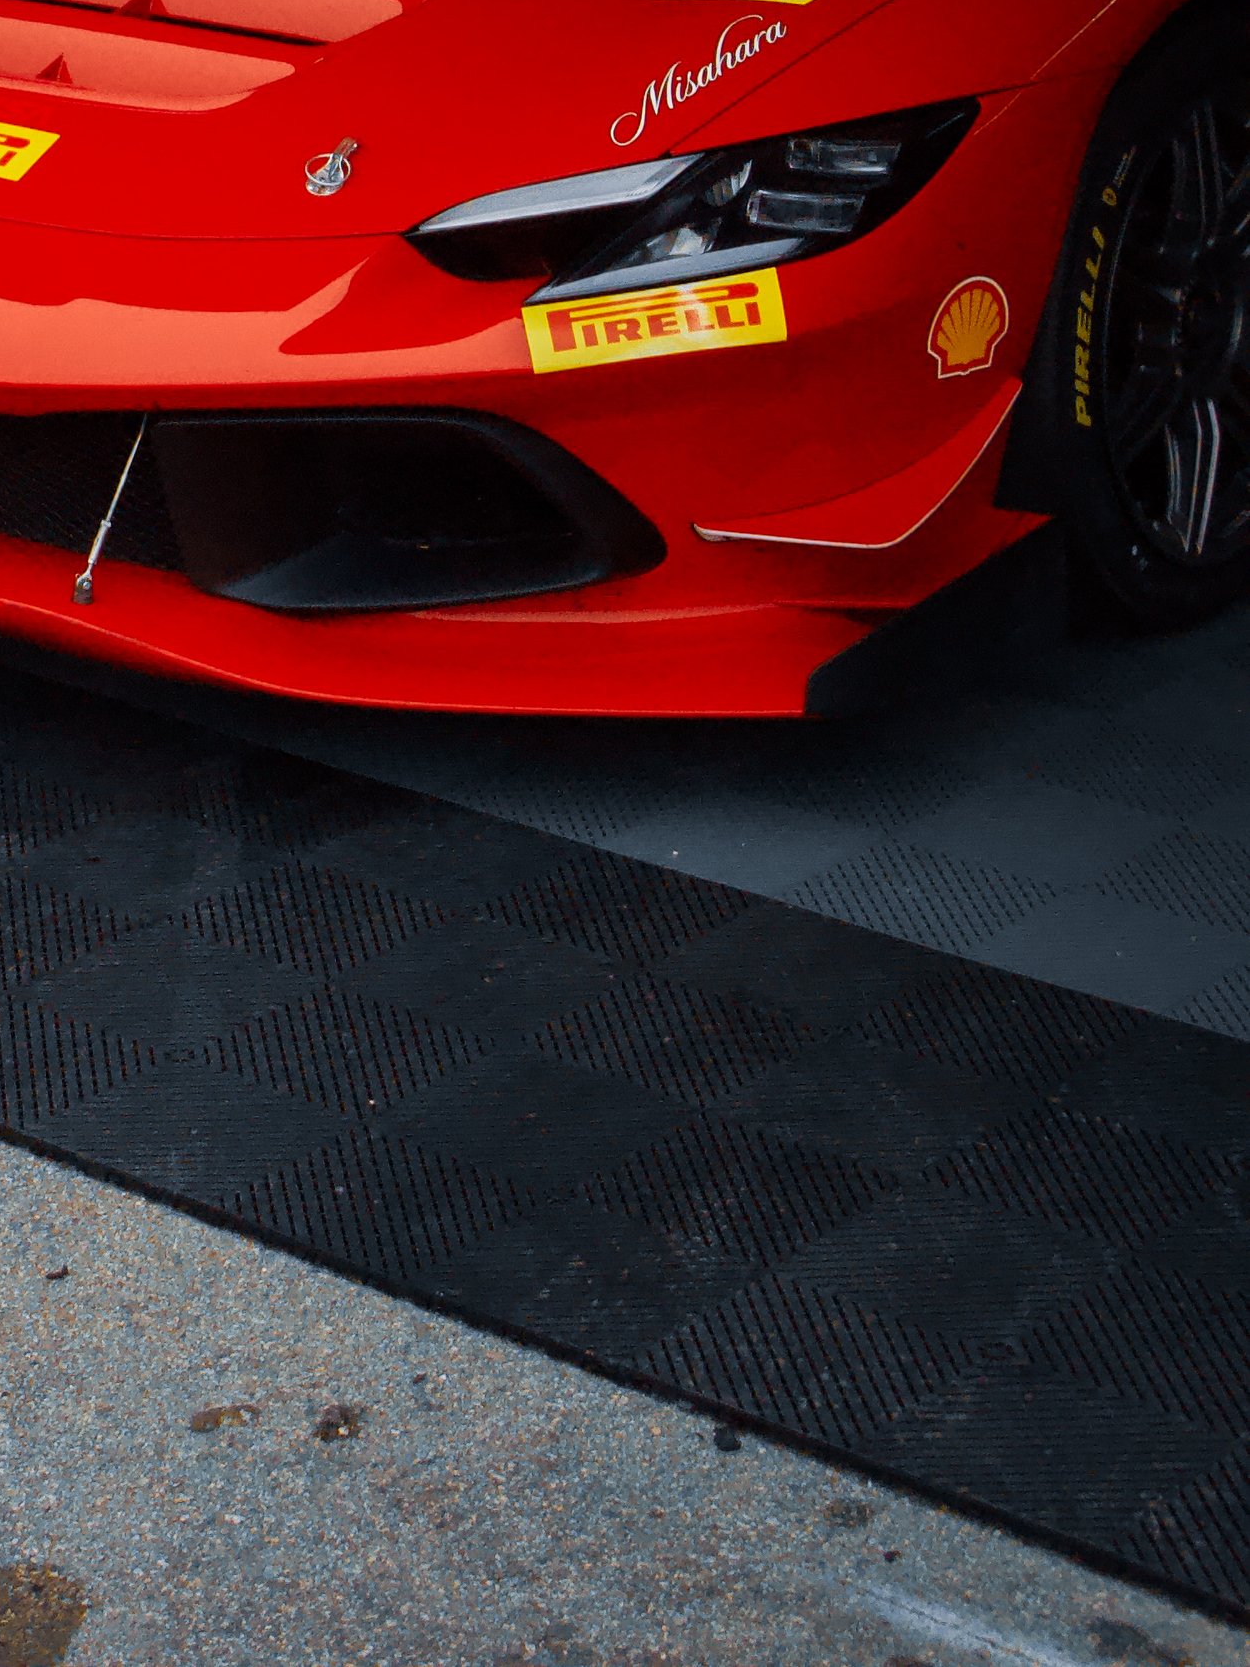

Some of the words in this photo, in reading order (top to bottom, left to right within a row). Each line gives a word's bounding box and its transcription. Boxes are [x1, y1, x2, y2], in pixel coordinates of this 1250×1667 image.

[610, 13, 787, 147] Misahara
[546, 282, 762, 353] PIRELLI
[1073, 224, 1106, 428] PIRELLI
